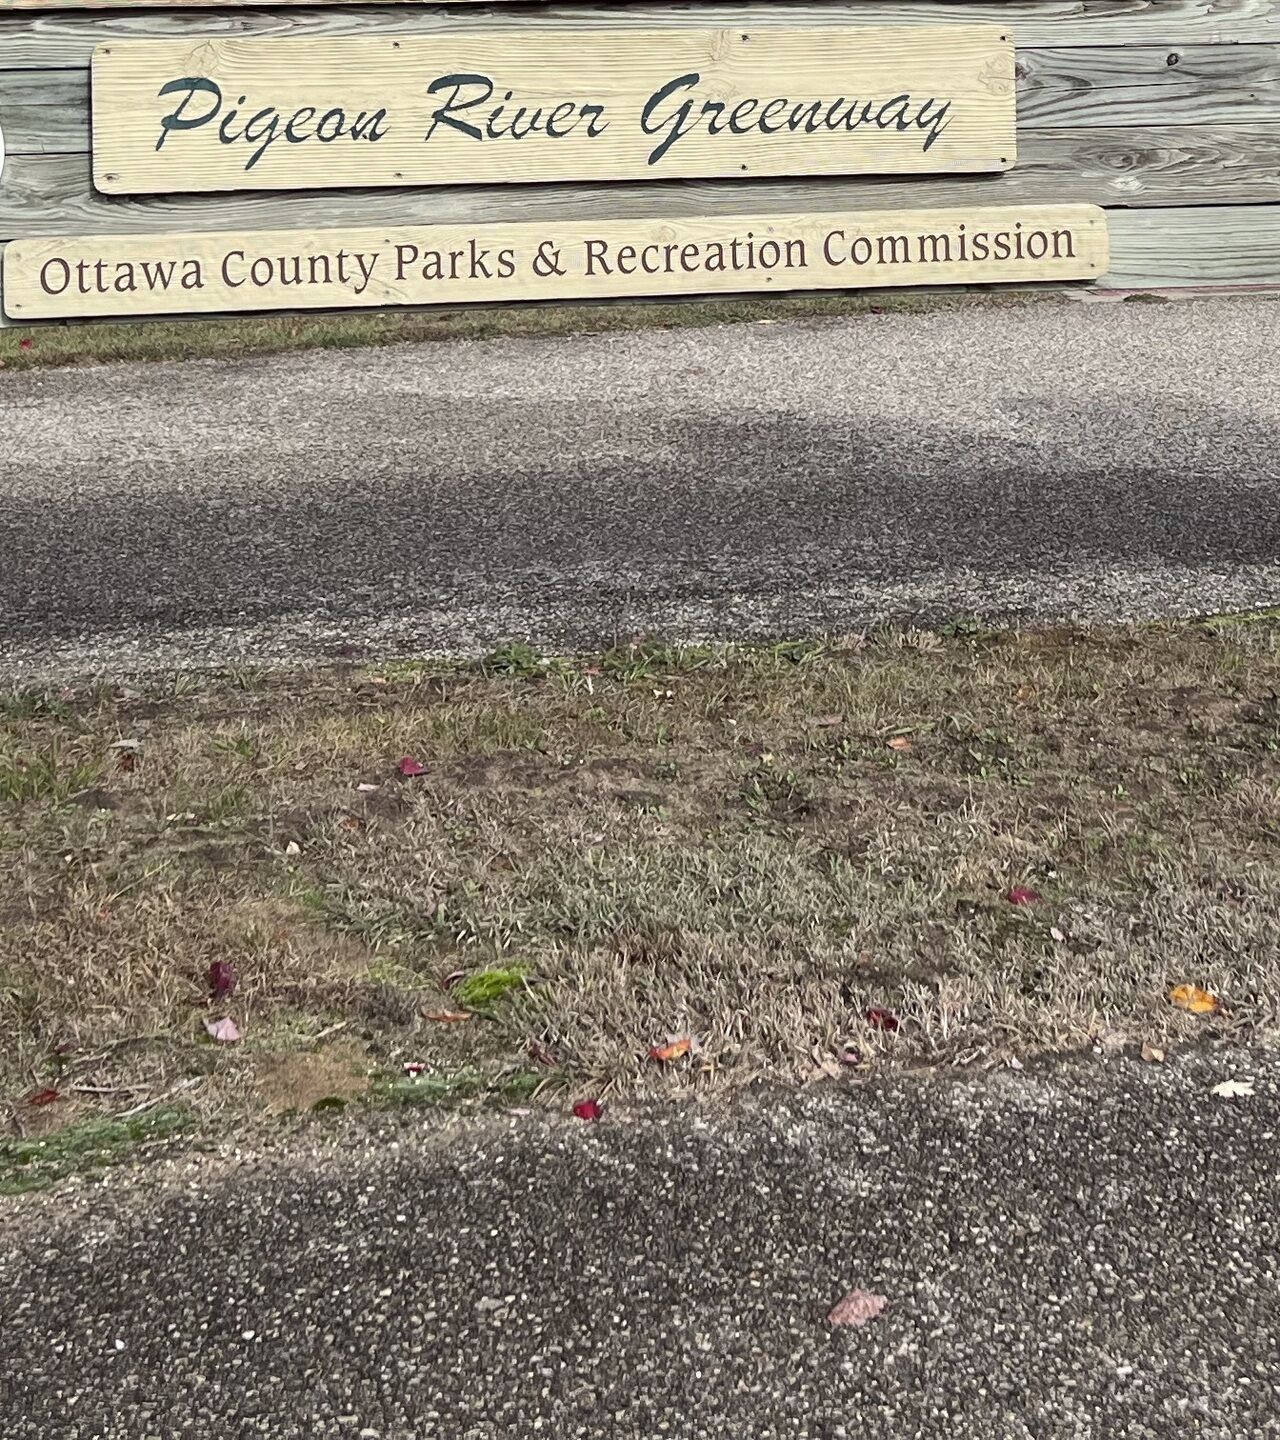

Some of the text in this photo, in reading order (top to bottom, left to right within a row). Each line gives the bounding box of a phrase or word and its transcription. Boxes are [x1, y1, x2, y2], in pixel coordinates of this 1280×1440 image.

[155, 72, 954, 171] Pigeon River Greenway
[39, 221, 1077, 295] Ottawa County Parks & Recreation Commission
